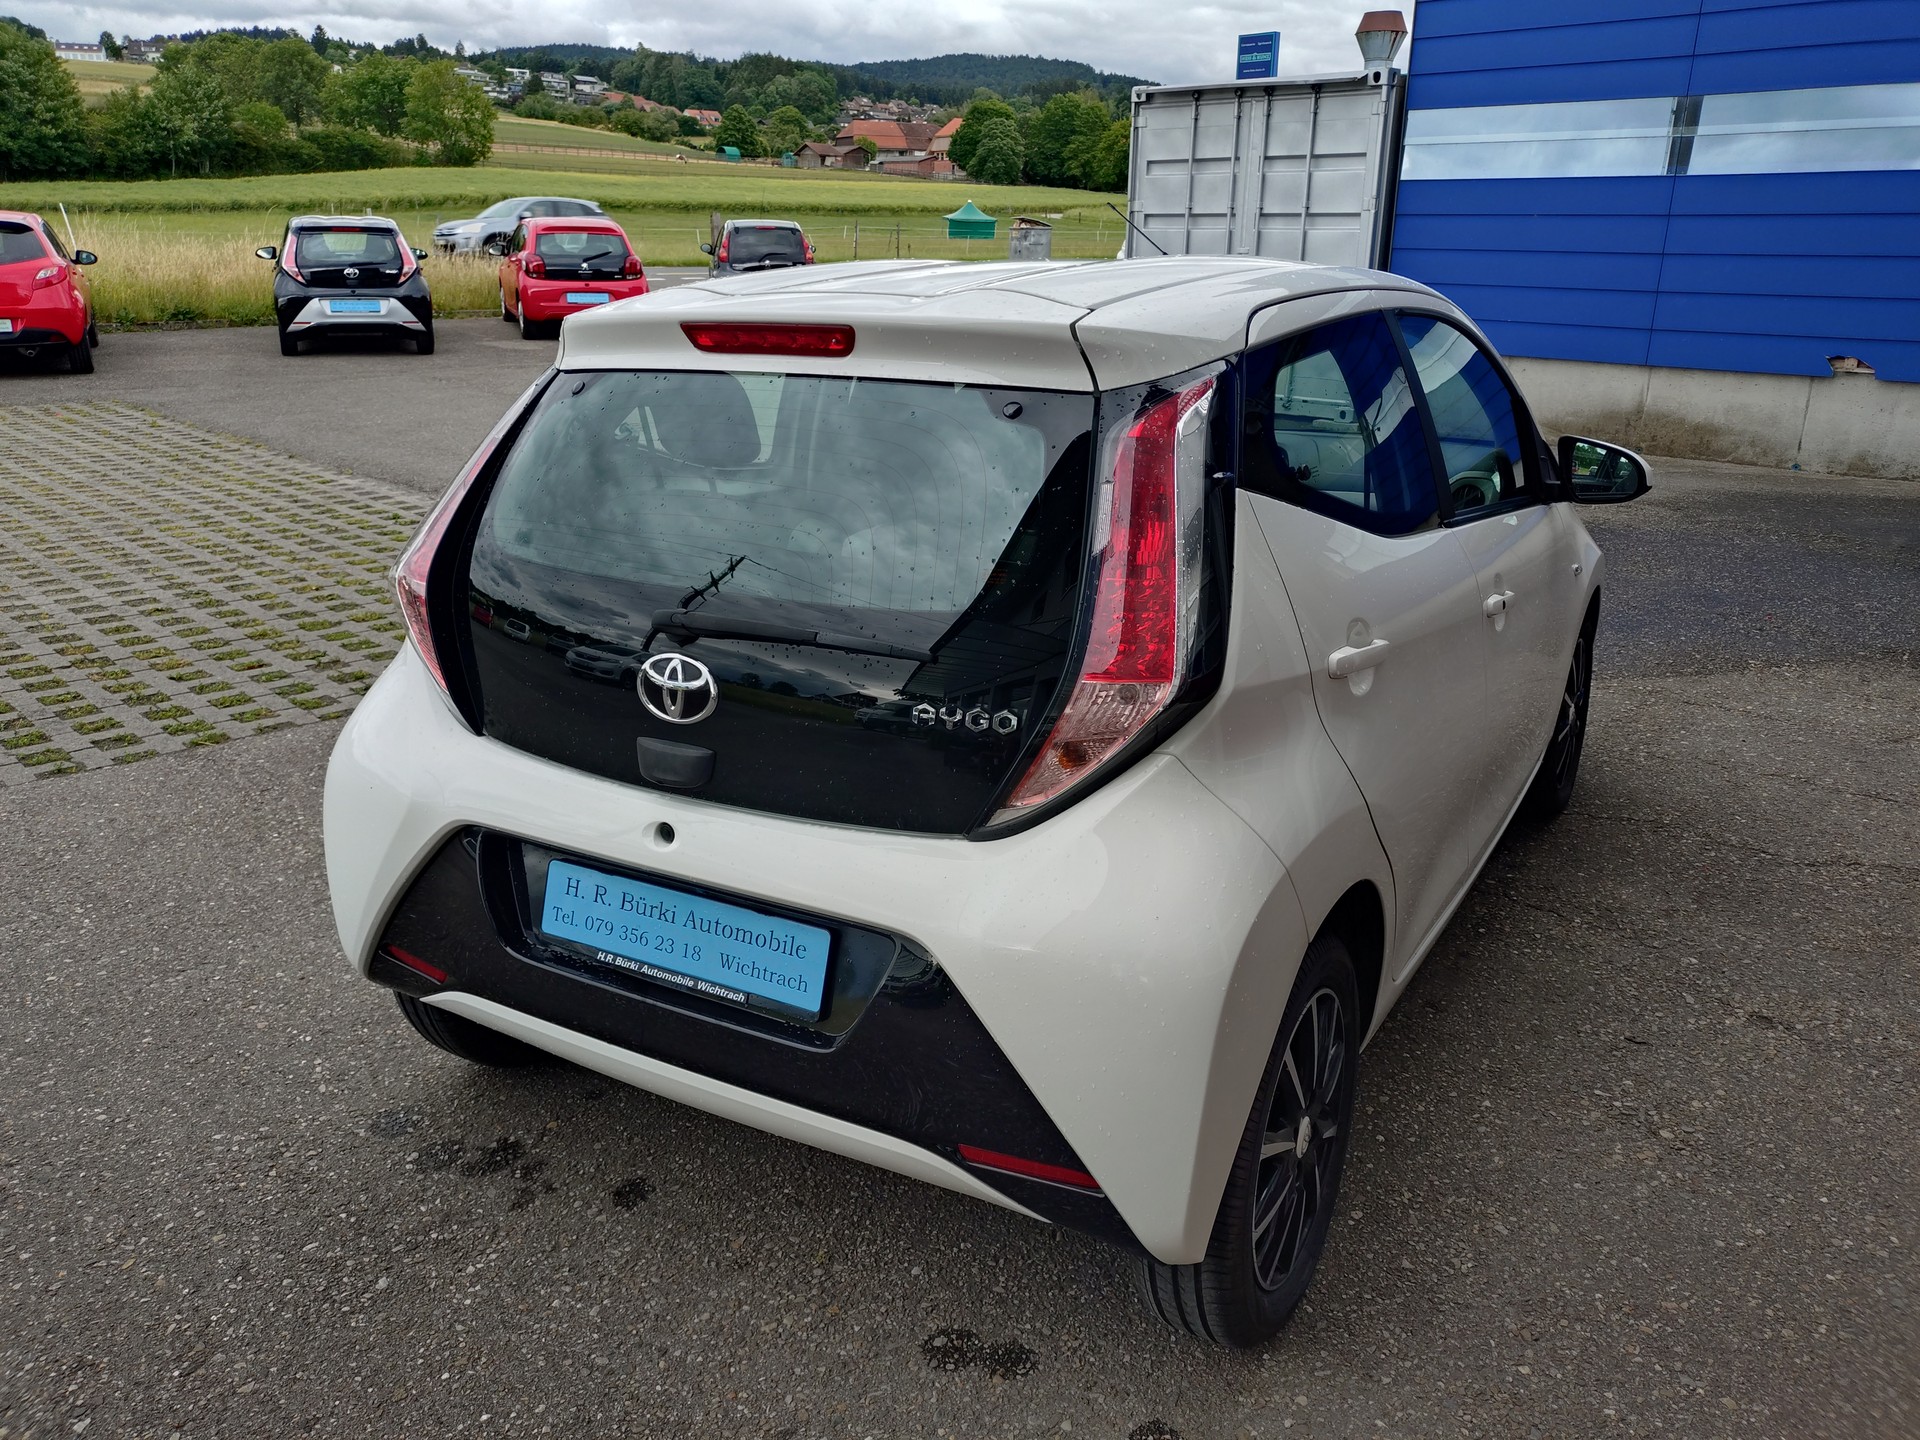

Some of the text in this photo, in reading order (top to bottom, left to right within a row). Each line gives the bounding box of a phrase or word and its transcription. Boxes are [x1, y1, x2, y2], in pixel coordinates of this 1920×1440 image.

[911, 702, 1018, 735] AYGO
[553, 906, 808, 993] Tel. 079 356 23 18 Wichtrach
[565, 877, 807, 960] H. R. Bürki Automobile
[615, 957, 640, 971] Bürki
[641, 965, 694, 987] Automobile
[697, 981, 745, 1002] Wichtrach
